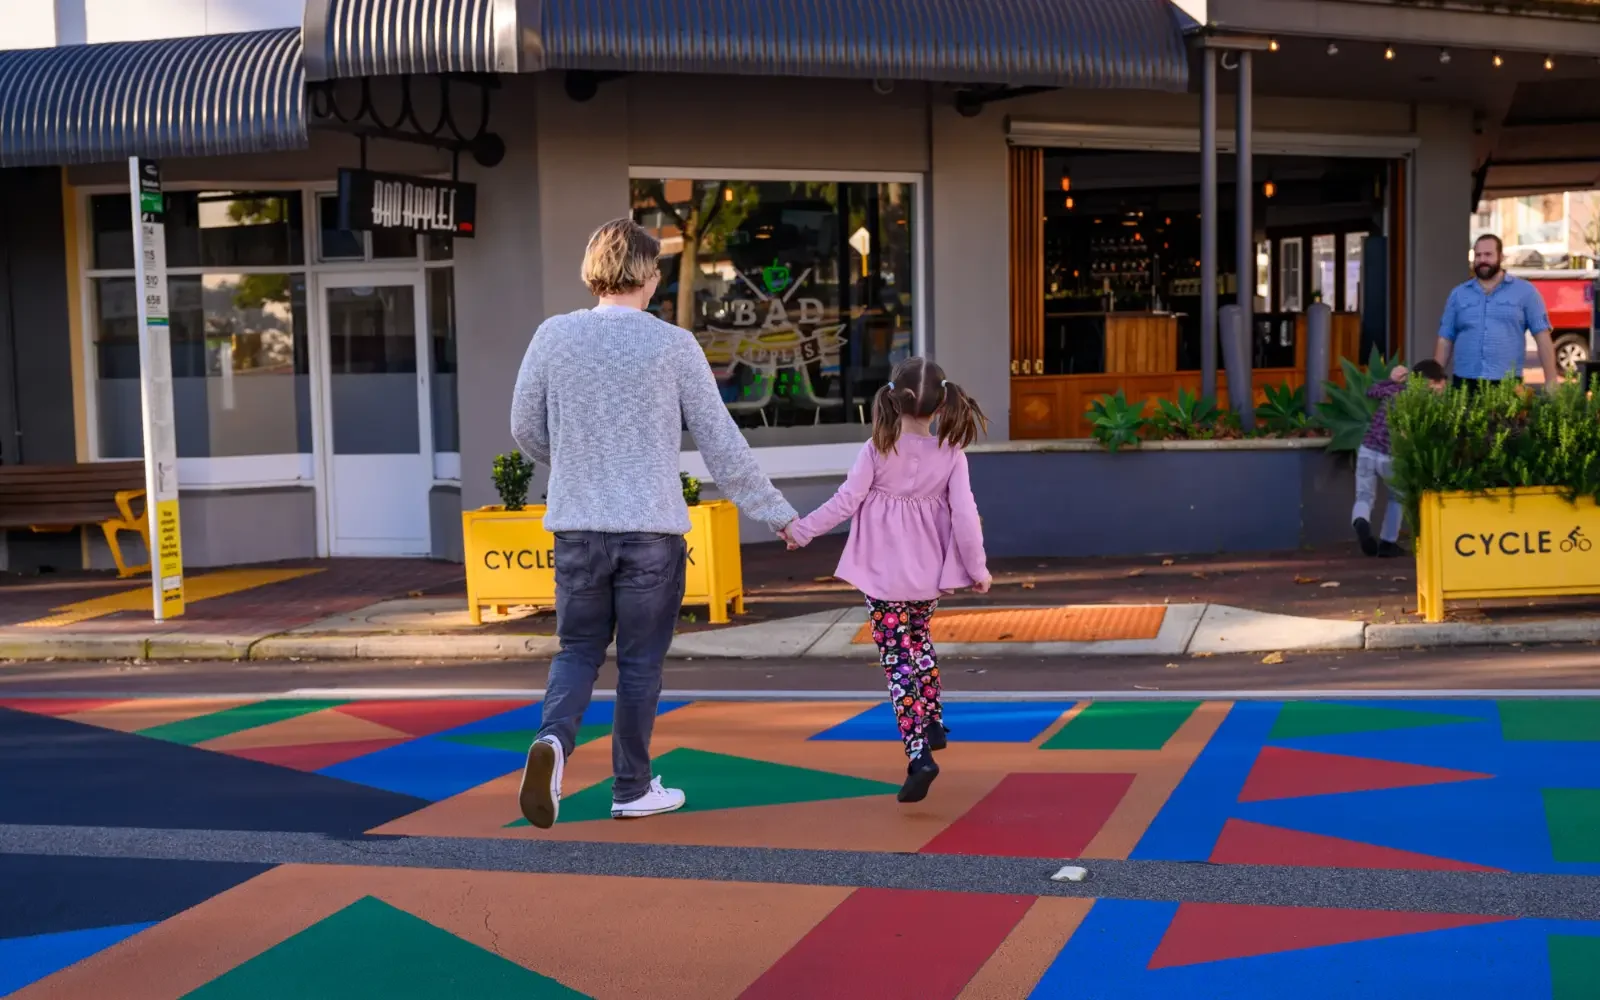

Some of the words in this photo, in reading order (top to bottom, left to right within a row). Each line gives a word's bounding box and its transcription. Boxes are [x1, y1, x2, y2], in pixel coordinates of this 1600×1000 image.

[371, 180, 402, 228] BAD
[146, 275, 159, 285] 510
[733, 298, 824, 328] BAD
[742, 343, 815, 362] APPLES
[1455, 531, 1552, 557] CYCLE
[484, 550, 556, 570] CYCLE
